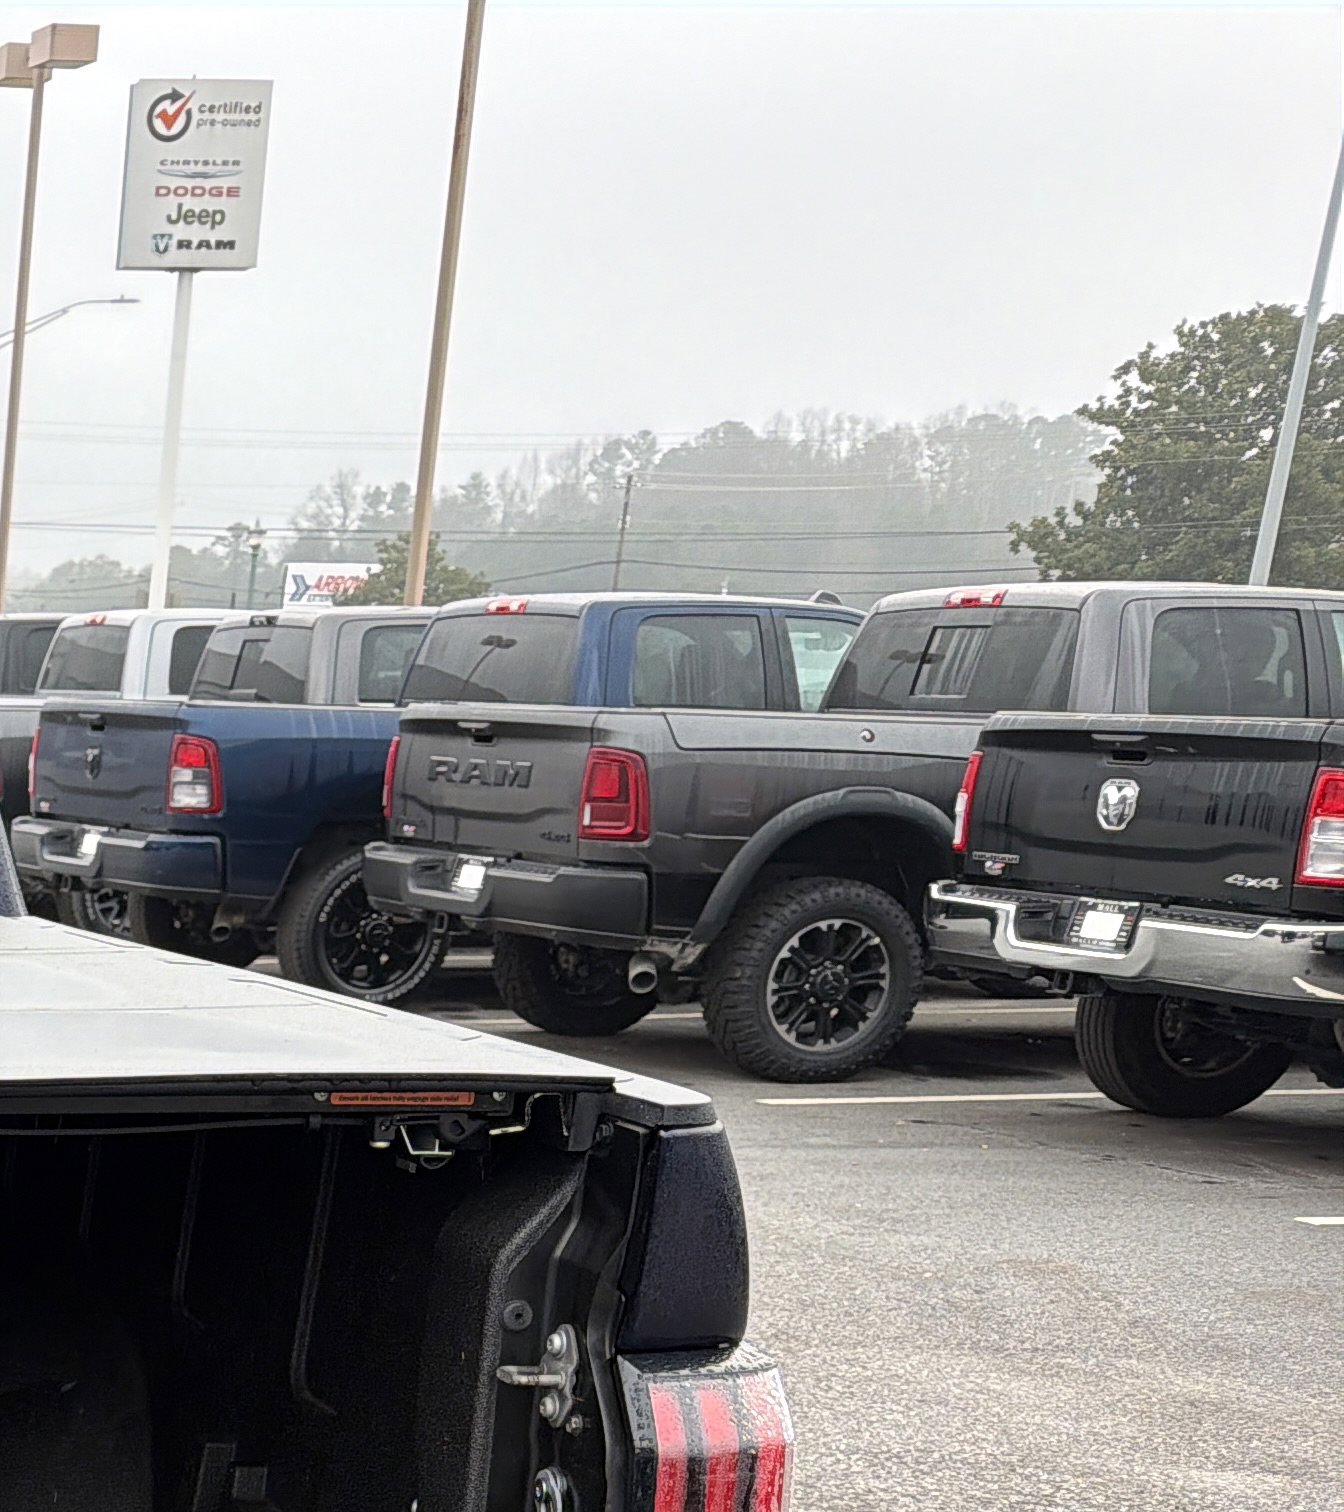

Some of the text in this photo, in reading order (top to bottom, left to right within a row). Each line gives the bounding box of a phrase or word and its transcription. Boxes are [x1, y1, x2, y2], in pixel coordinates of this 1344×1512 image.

[197, 101, 262, 115] certified
[196, 117, 261, 129] pre-owned
[159, 158, 241, 167] CHRYSLER
[154, 185, 241, 198] DODGE
[166, 202, 226, 230] Jeep
[176, 239, 237, 251] RAM
[427, 755, 534, 789] RAM
[1223, 873, 1284, 891] 4x4
